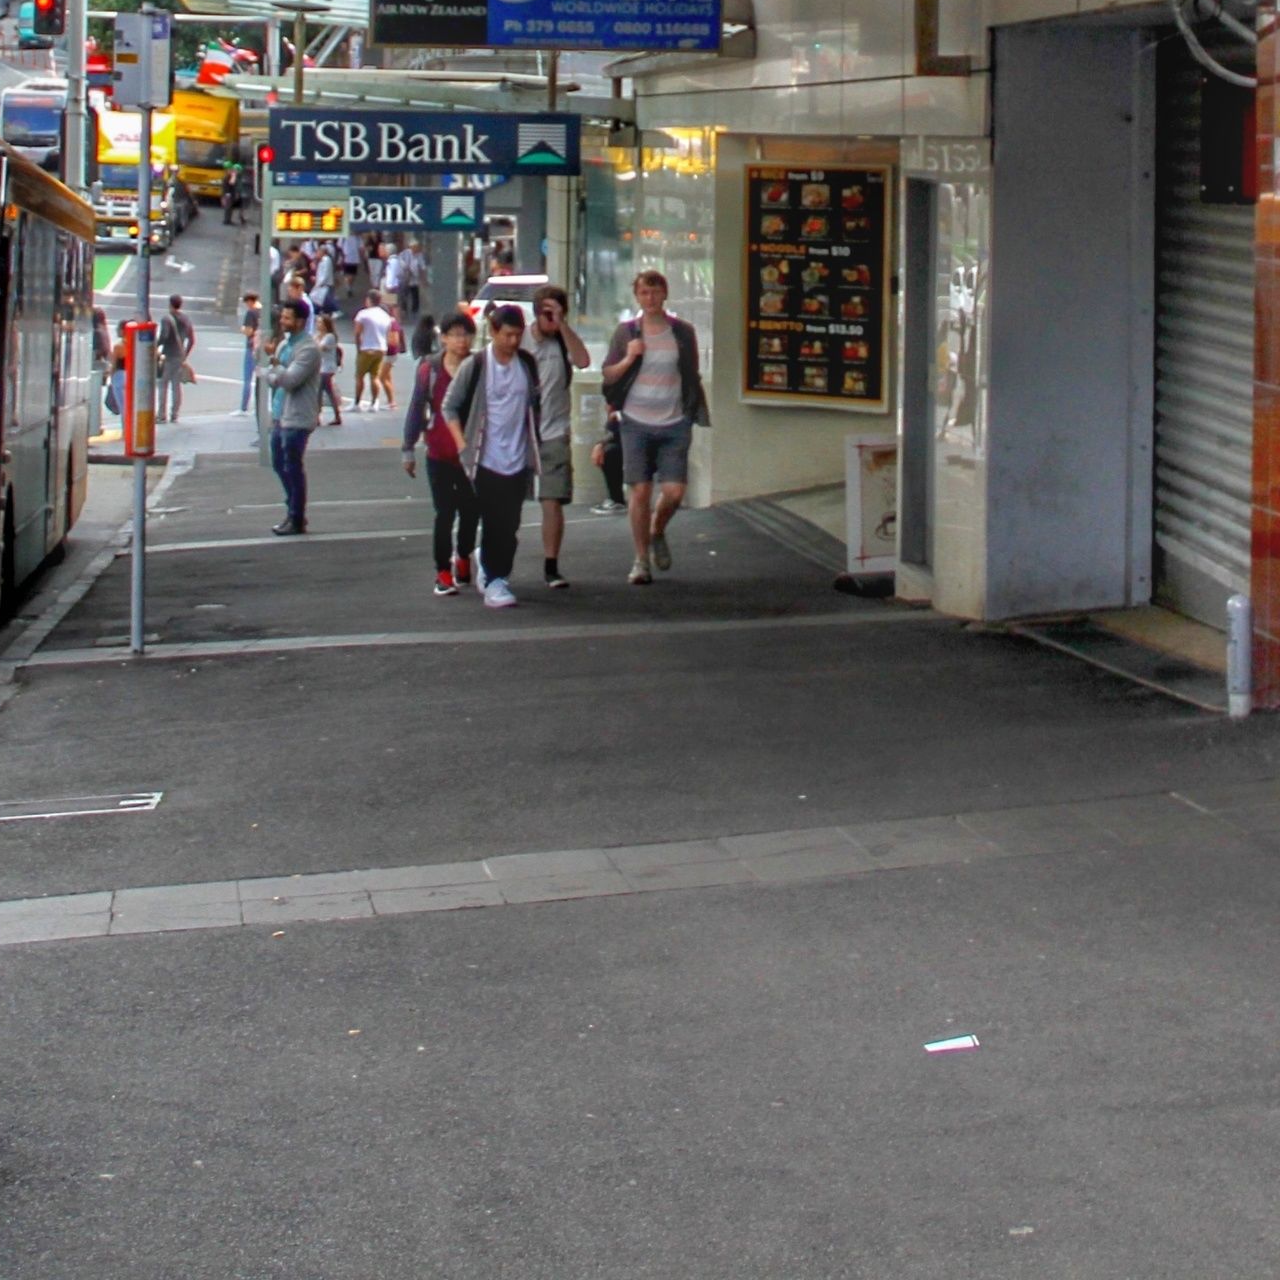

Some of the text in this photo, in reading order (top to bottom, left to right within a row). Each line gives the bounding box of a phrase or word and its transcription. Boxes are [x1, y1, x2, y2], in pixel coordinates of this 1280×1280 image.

[281, 119, 491, 164] TSB Bank
[349, 195, 423, 225] Bank
